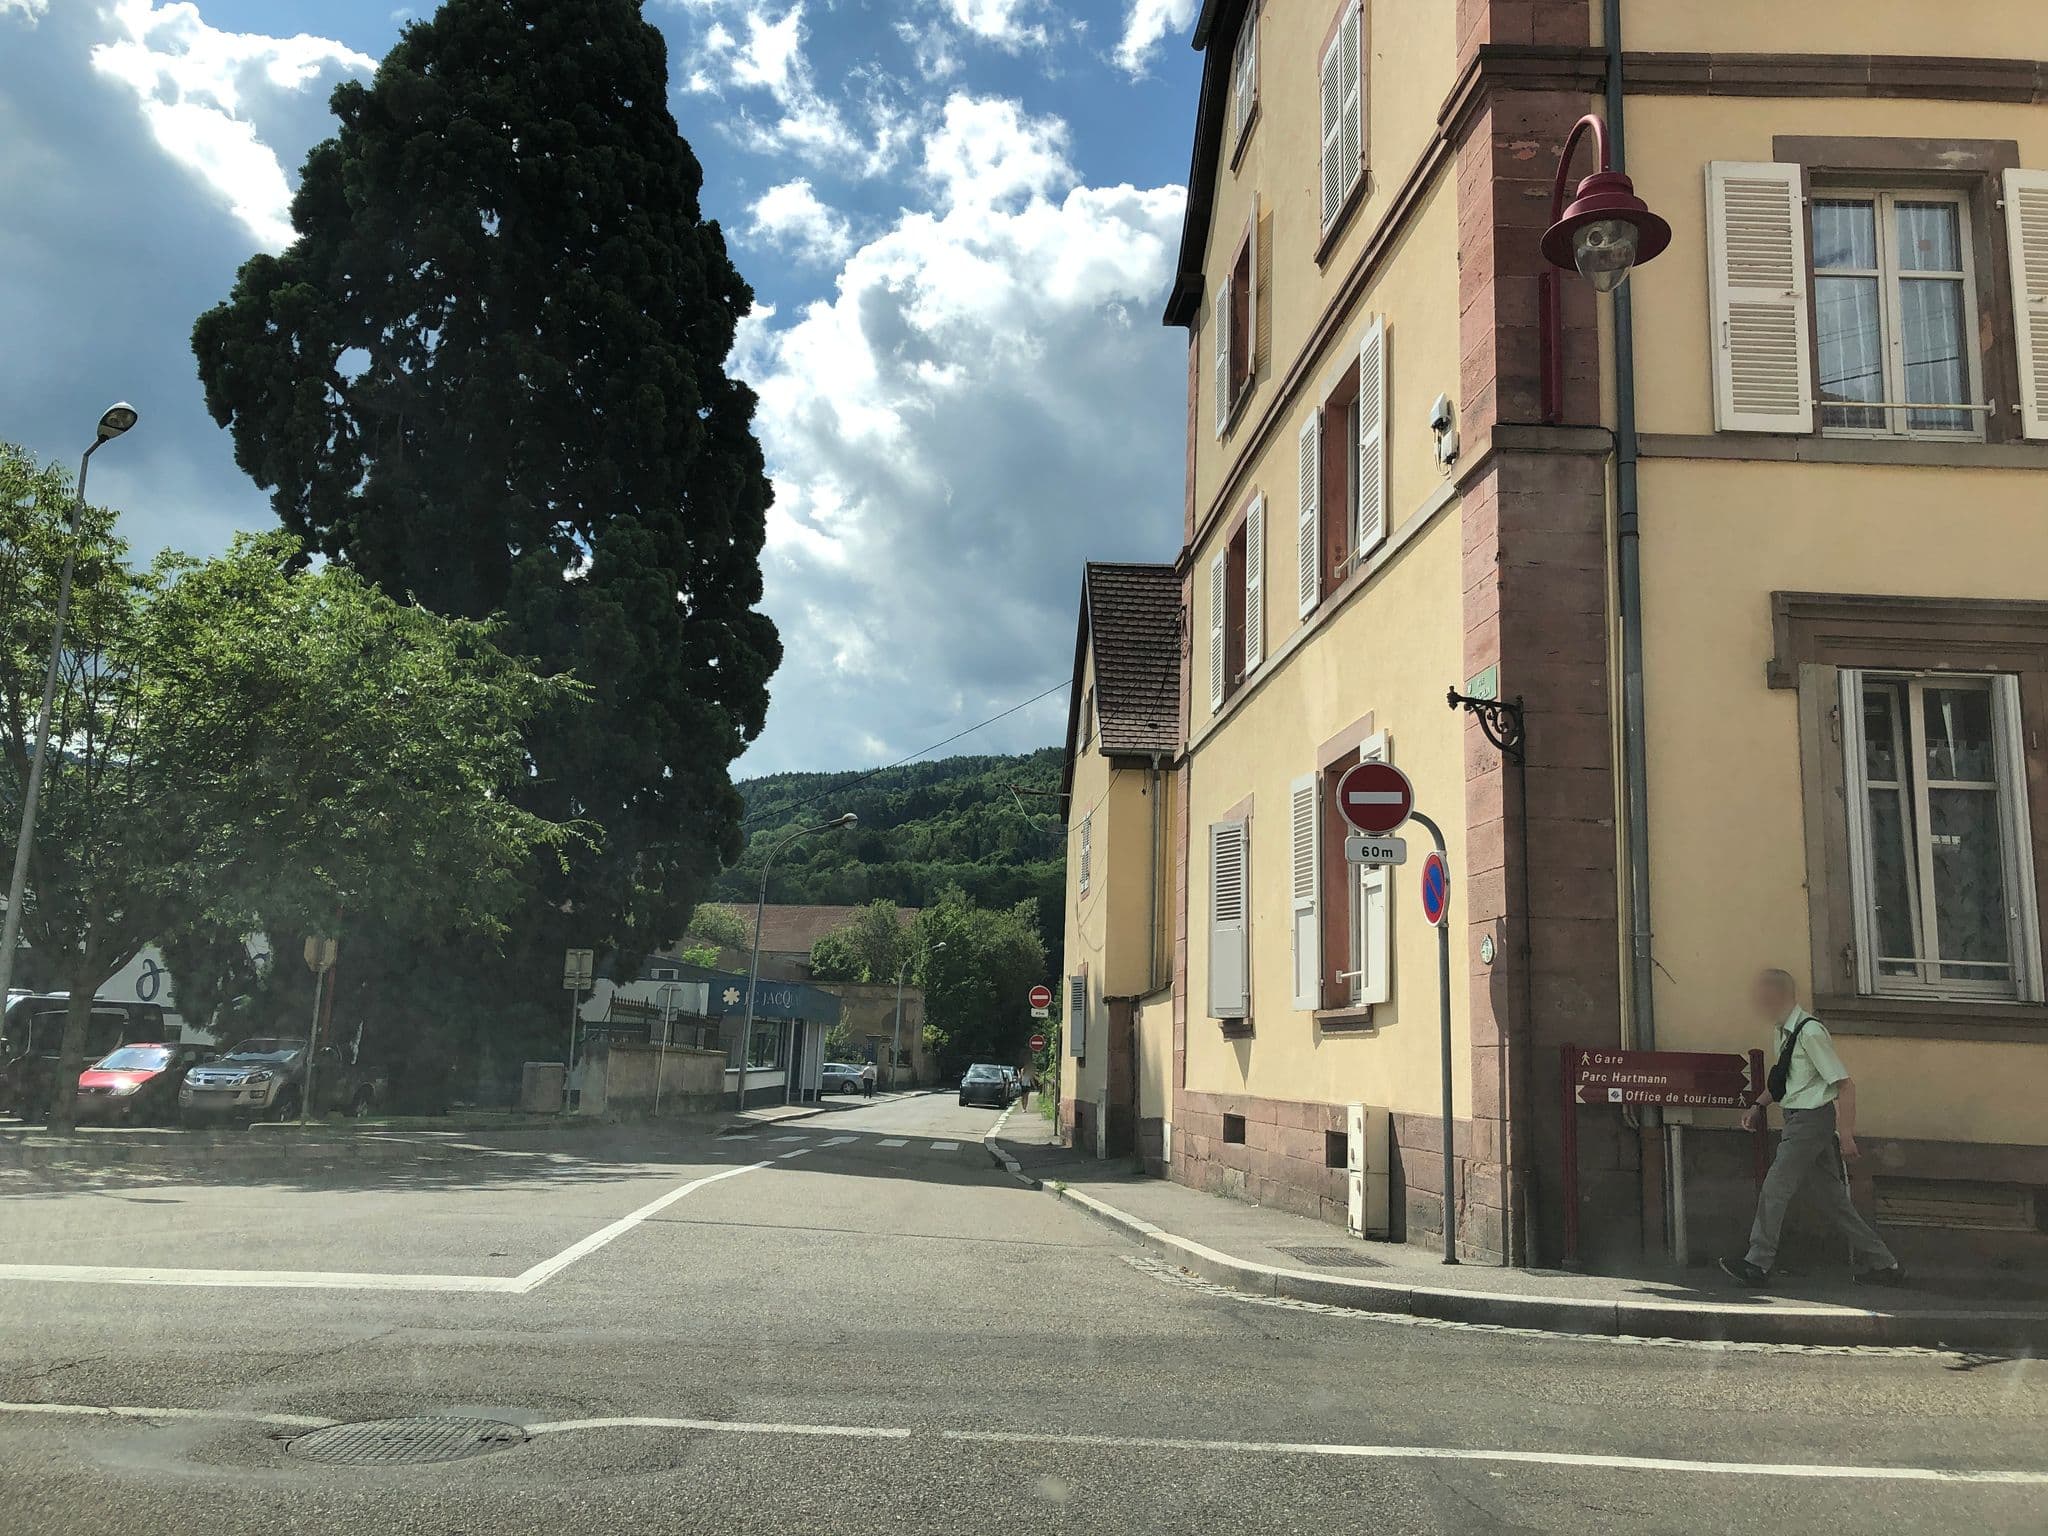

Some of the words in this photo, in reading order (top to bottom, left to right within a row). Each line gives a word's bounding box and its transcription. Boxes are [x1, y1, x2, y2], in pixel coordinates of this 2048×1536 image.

[1361, 846, 1393, 858] 60m
[1594, 1053, 1624, 1064] Gare
[1582, 1071, 1607, 1082] Parc
[1612, 1072, 1667, 1084] Hartmann
[1625, 1090, 1661, 1102] Office
[1666, 1092, 1679, 1103] de
[1683, 1093, 1735, 1105] tourisme
